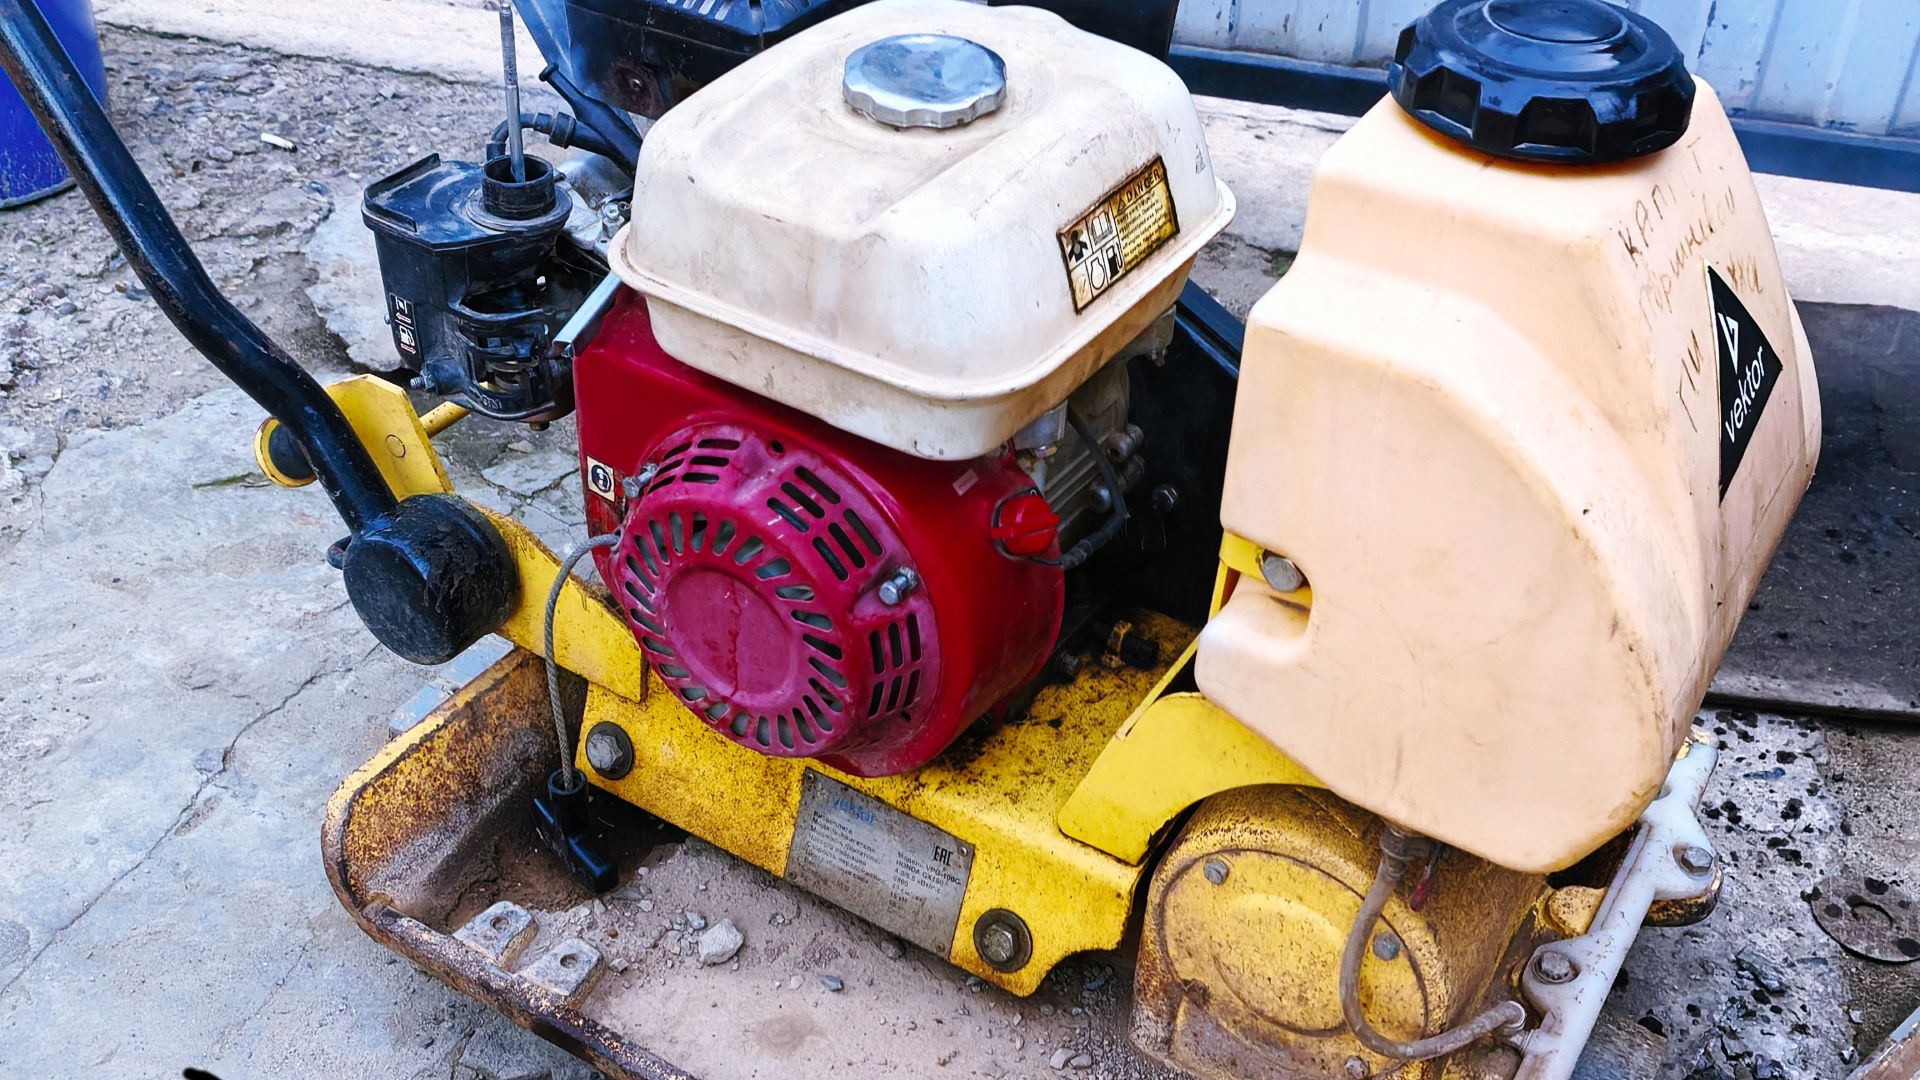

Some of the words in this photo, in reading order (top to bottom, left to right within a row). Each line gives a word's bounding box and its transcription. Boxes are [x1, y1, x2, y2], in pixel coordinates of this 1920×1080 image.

[1126, 169, 1160, 201] DANGER
[1725, 346, 1765, 443] vektor
[895, 858, 920, 875] HONDA
